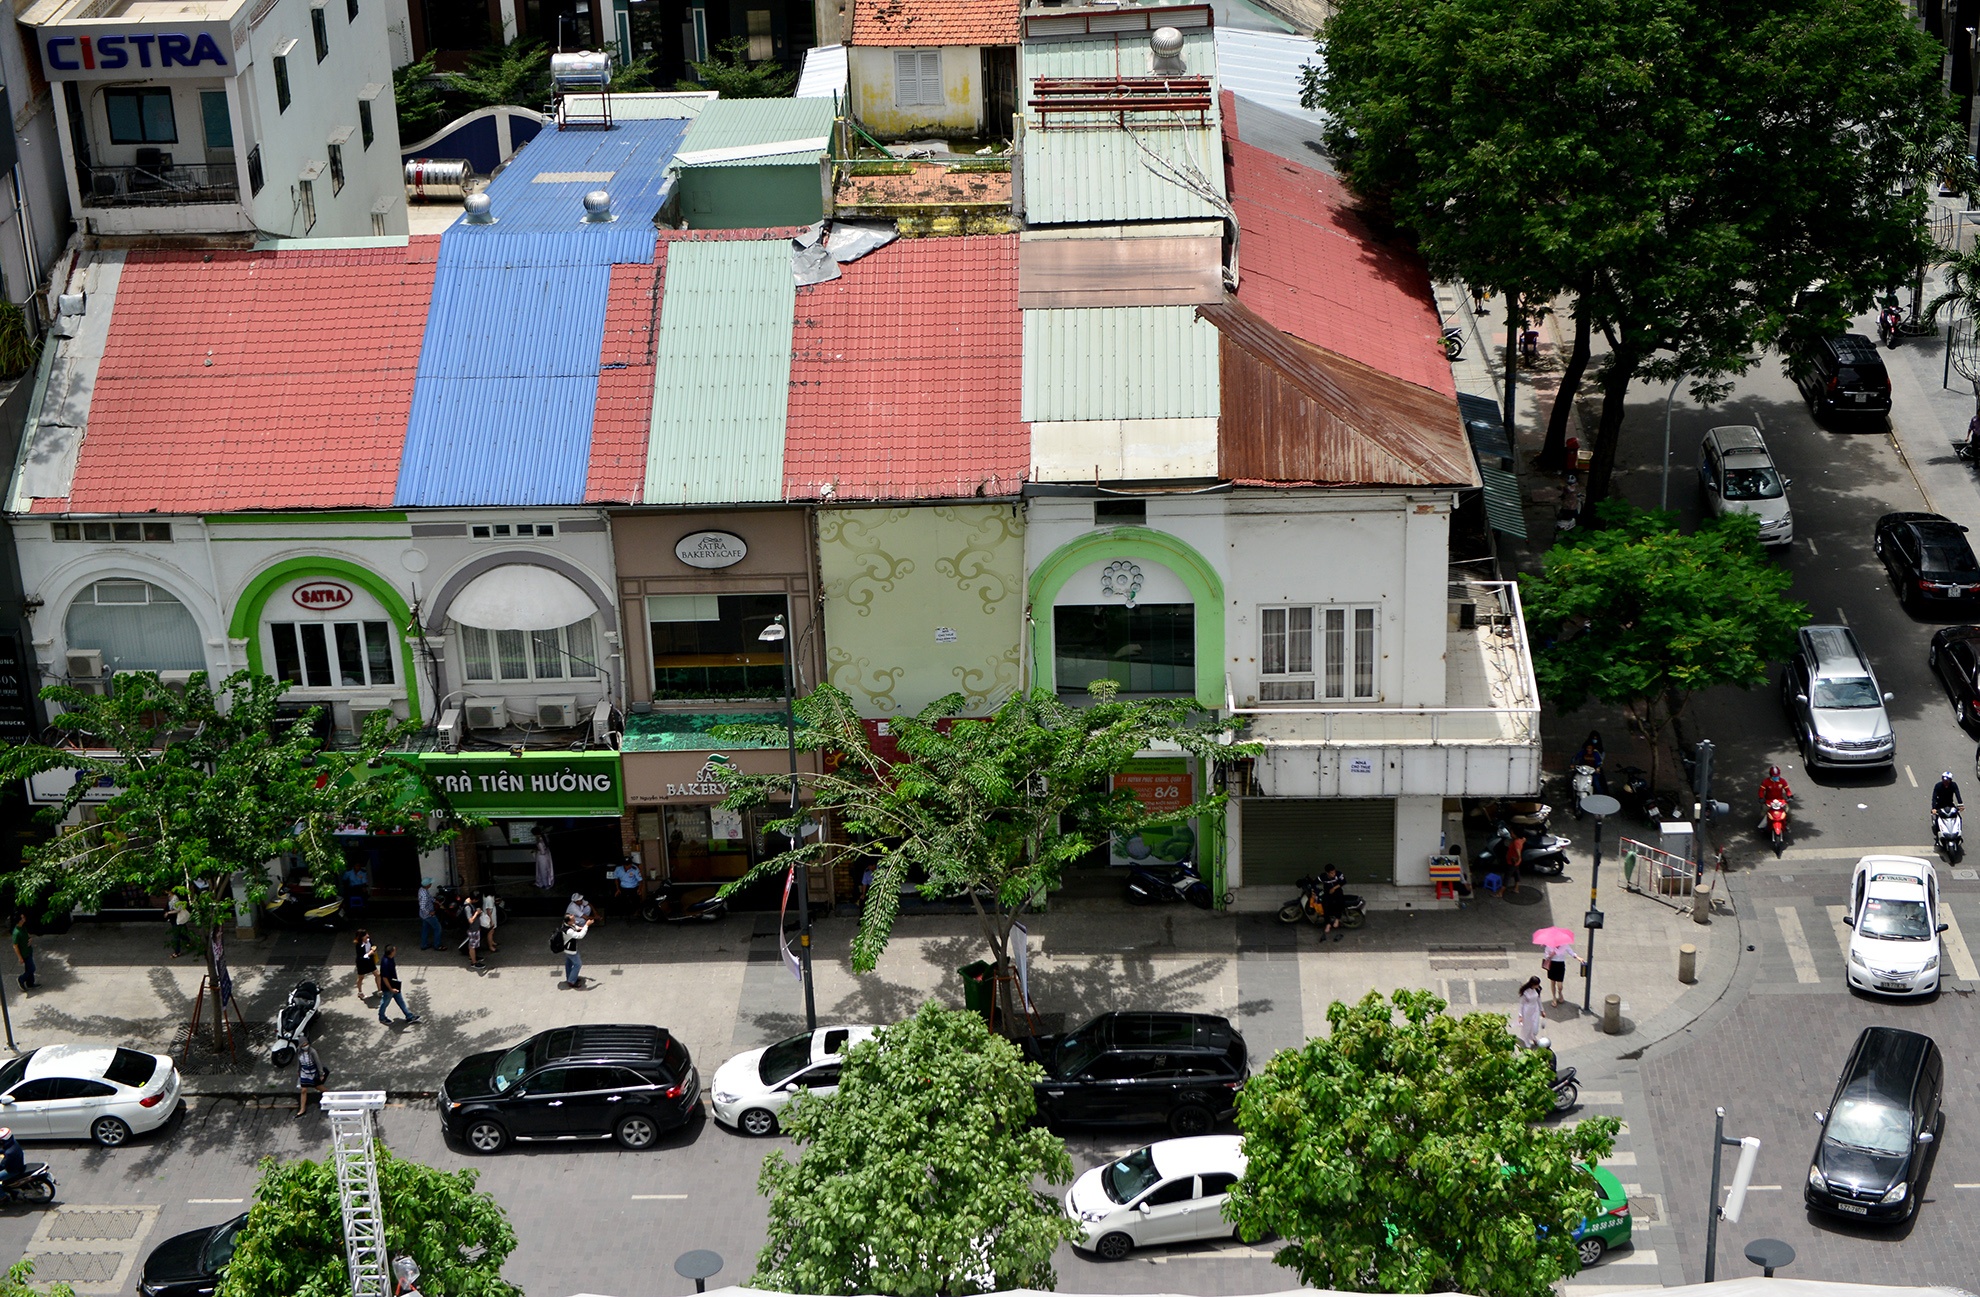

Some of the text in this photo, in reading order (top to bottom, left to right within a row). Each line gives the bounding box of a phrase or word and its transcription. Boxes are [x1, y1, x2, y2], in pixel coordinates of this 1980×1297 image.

[698, 542, 727, 550] SATRA
[301, 589, 346, 603] SATRA
[479, 770, 524, 792] TIÊN
[531, 767, 611, 792] HƯỞNG
[666, 783, 728, 796] BAKERY
[1154, 785, 1179, 798] 8/8
